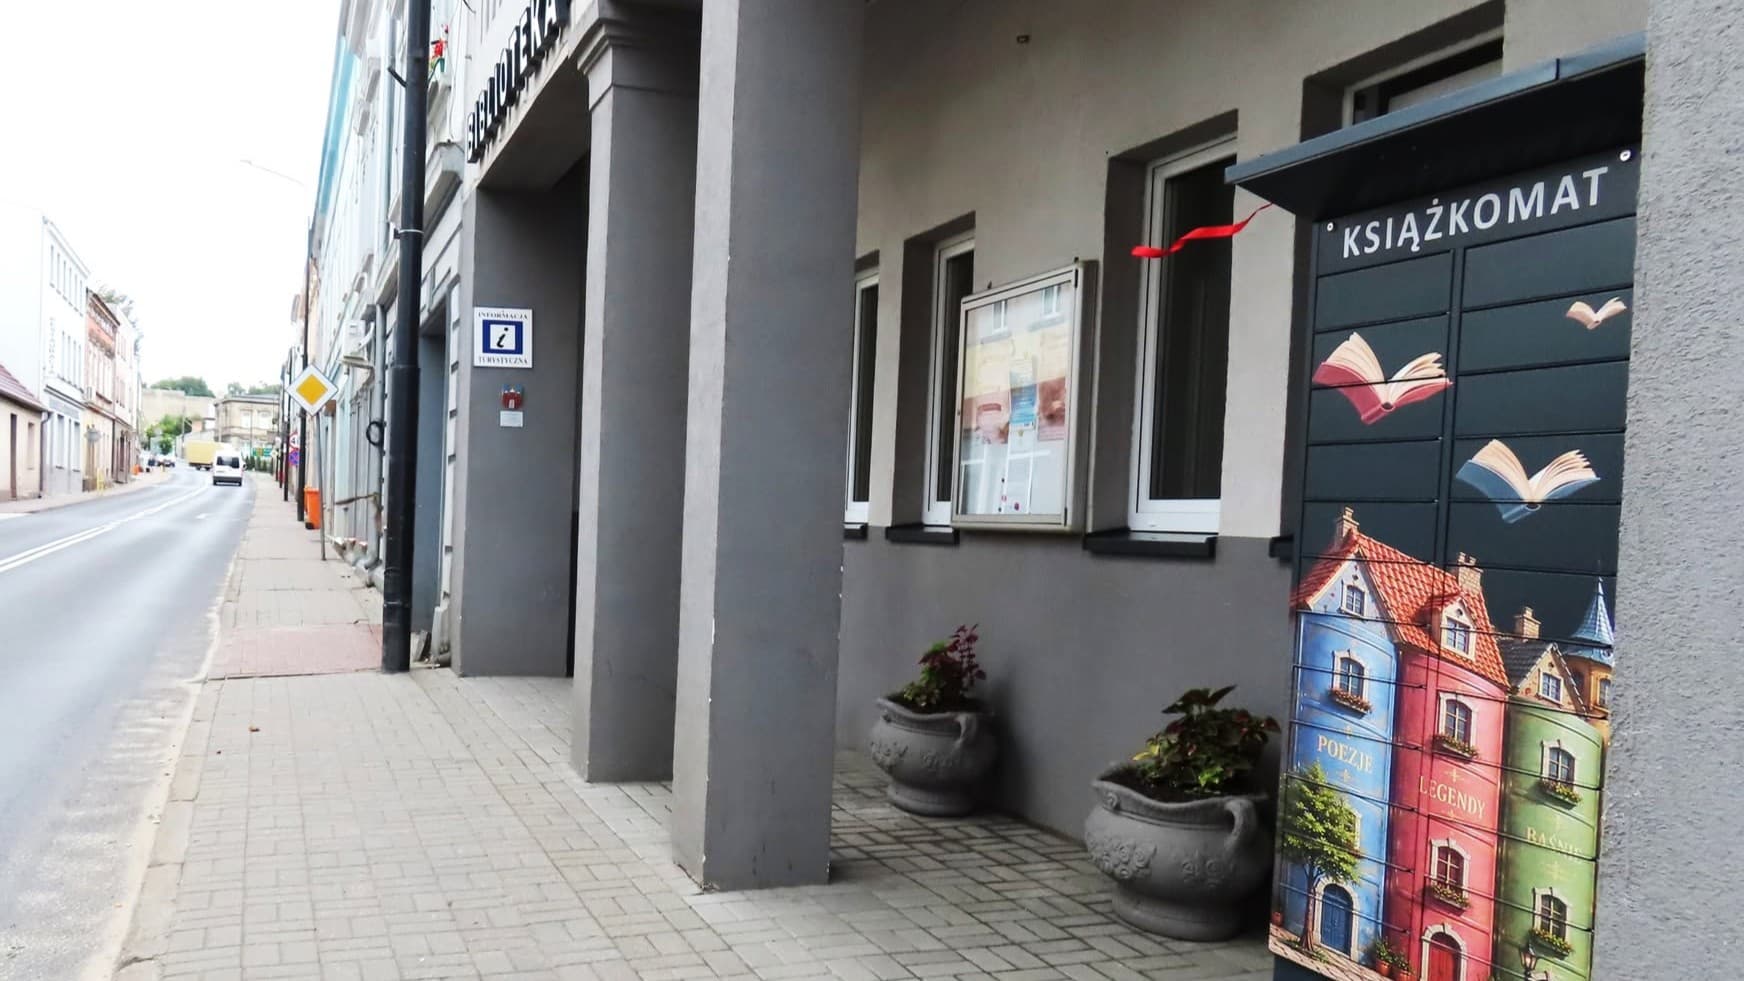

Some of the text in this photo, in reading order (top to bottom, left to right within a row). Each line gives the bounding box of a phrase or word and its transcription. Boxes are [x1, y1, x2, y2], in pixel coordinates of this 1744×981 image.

[467, 0, 568, 162] BIBLIOTEKA
[1343, 167, 1608, 258] KSIĄŻKOMAT
[478, 311, 528, 320] INFORMACJA
[496, 327, 509, 348] i
[479, 356, 528, 365] TURYSTYCZNA
[1317, 734, 1373, 774] POEZJE
[1419, 775, 1486, 820] LEGENDY
